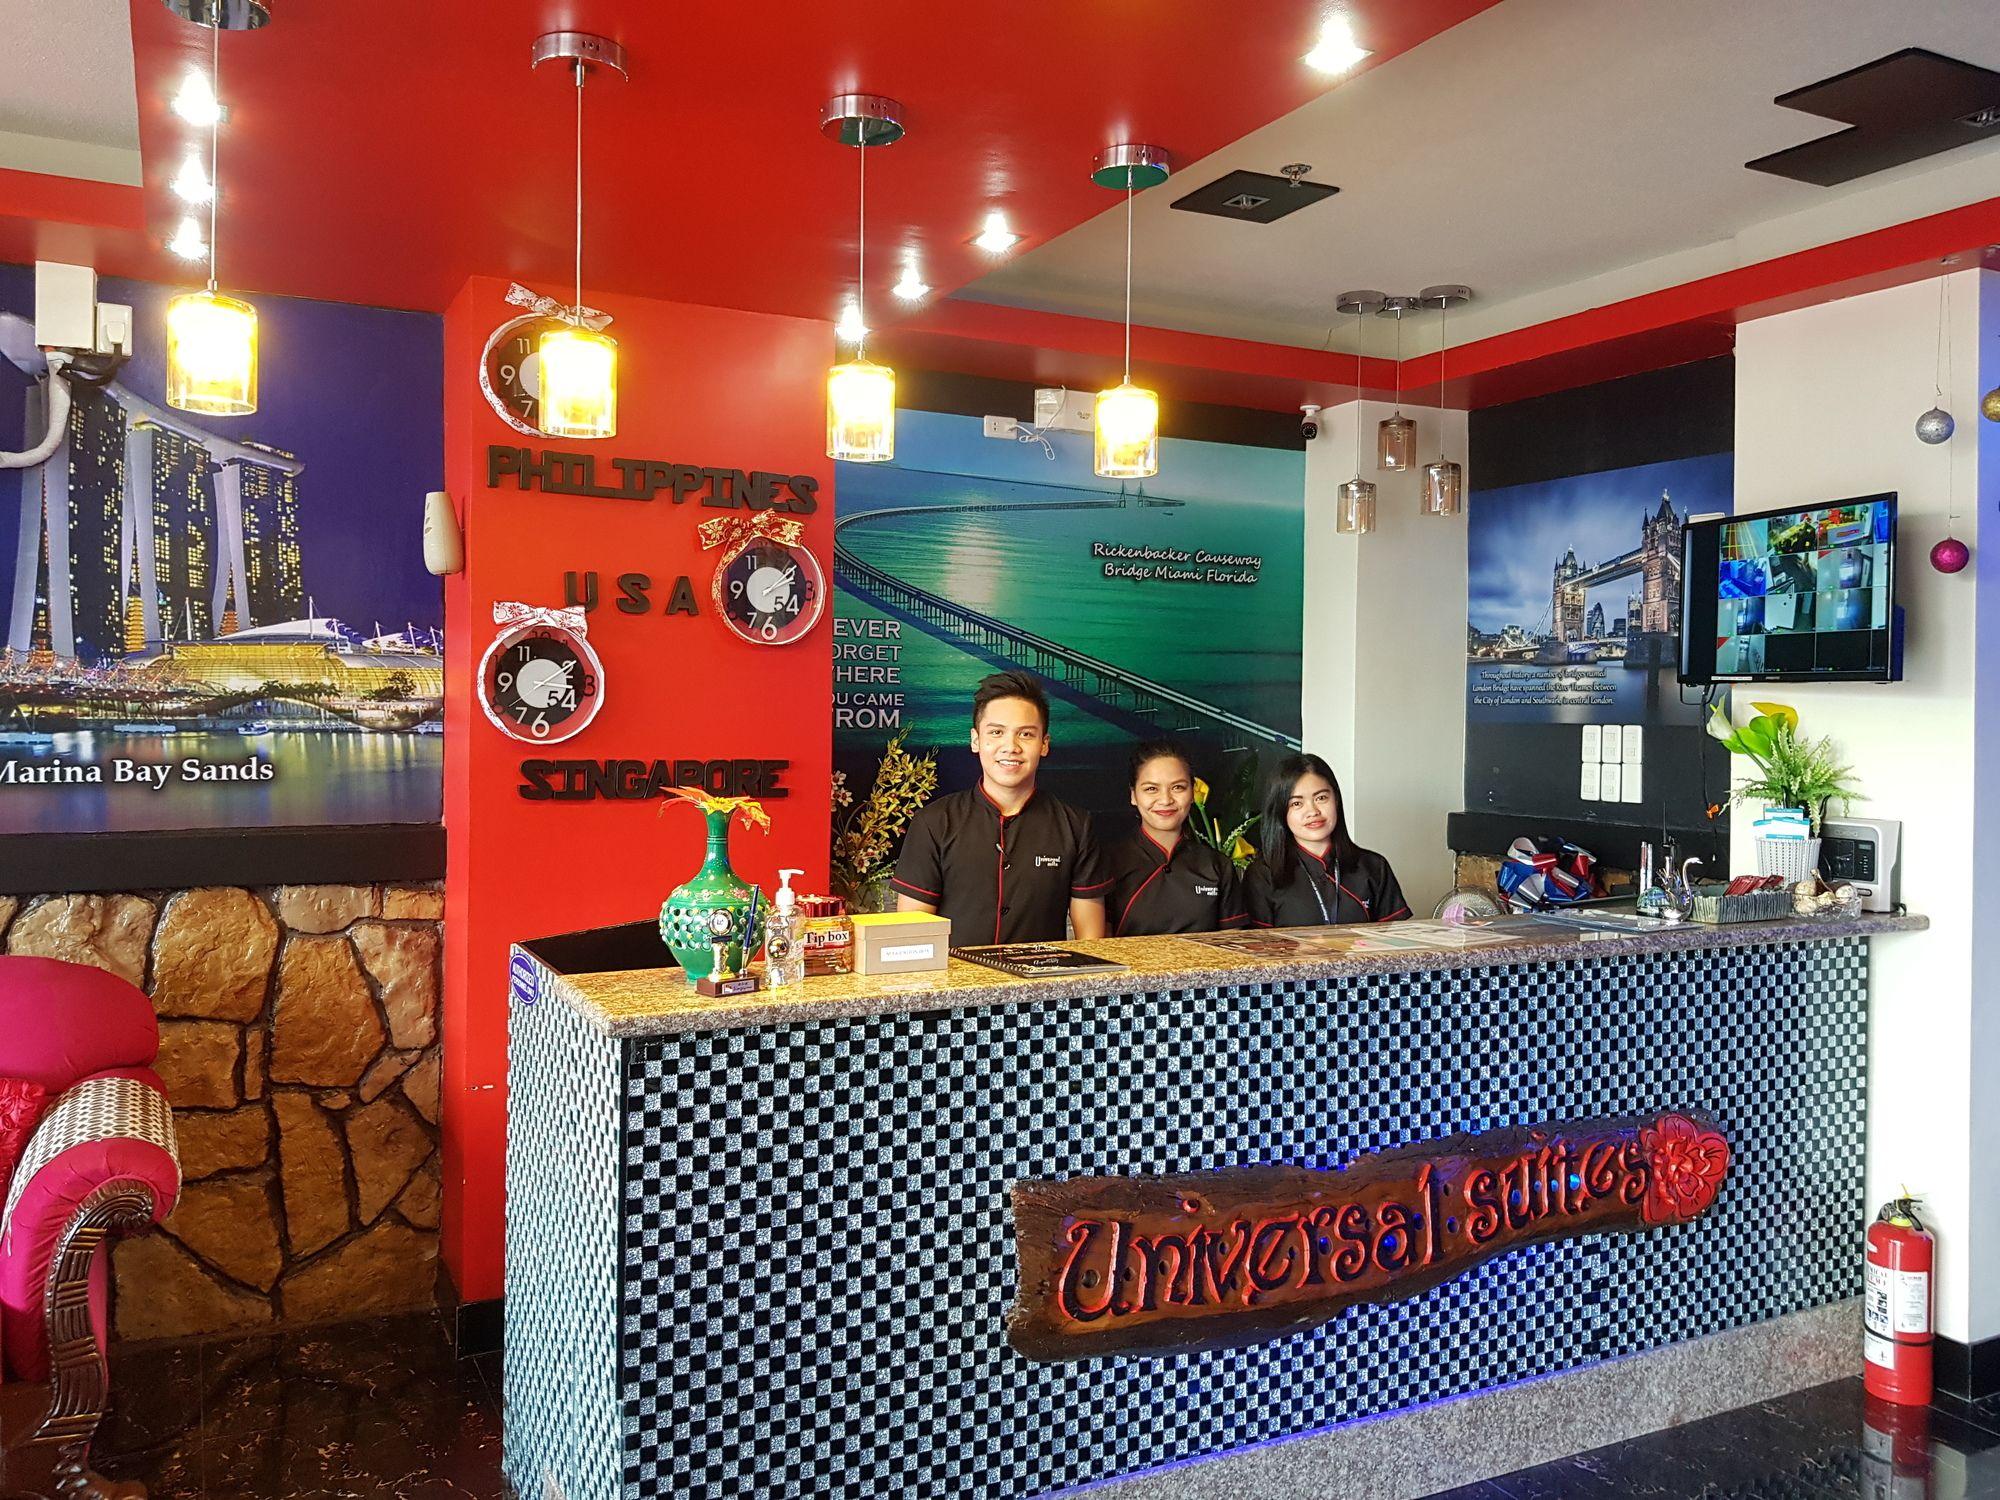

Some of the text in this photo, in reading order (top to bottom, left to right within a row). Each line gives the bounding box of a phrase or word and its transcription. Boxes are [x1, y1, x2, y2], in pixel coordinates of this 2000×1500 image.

[516, 338, 531, 354] 11
[500, 365, 516, 385] 9
[521, 400, 533, 418] 7
[487, 445, 819, 514] PHILIPPINES
[745, 555, 758, 570] 11
[1093, 543, 1262, 569] Rickenbacker Causeway
[1104, 562, 1258, 584] Bridge Miami Florida
[730, 580, 744, 600] 9
[774, 596, 784, 612] 5
[785, 594, 800, 616] 4
[747, 612, 758, 629] 7
[761, 616, 778, 641] 6
[832, 618, 901, 639] EVER
[517, 646, 530, 662] 11
[497, 672, 514, 693] 9
[831, 666, 901, 684] HERE
[1481, 670, 1511, 681] Throughout
[547, 690, 559, 707] 5
[1472, 684, 1492, 692] London
[1493, 684, 1509, 694] Bridge
[1510, 684, 1522, 692] have
[1593, 683, 1616, 691] between
[561, 689, 577, 712] 4
[853, 693, 905, 706] CAME
[1473, 696, 1482, 704] the
[1482, 696, 1493, 706] City
[1493, 696, 1501, 706] of
[1500, 696, 1521, 704] London
[1521, 696, 1532, 704] and
[1569, 696, 1590, 704] central
[515, 706, 528, 724] 7
[531, 711, 550, 738] 6
[831, 708, 900, 729] ROM
[0, 757, 274, 790] Marina Bay Sands
[517, 759, 790, 800] SINGAPORE
[805, 931, 848, 946] Tip box
[1057, 1130, 1652, 1323] Universal suites
